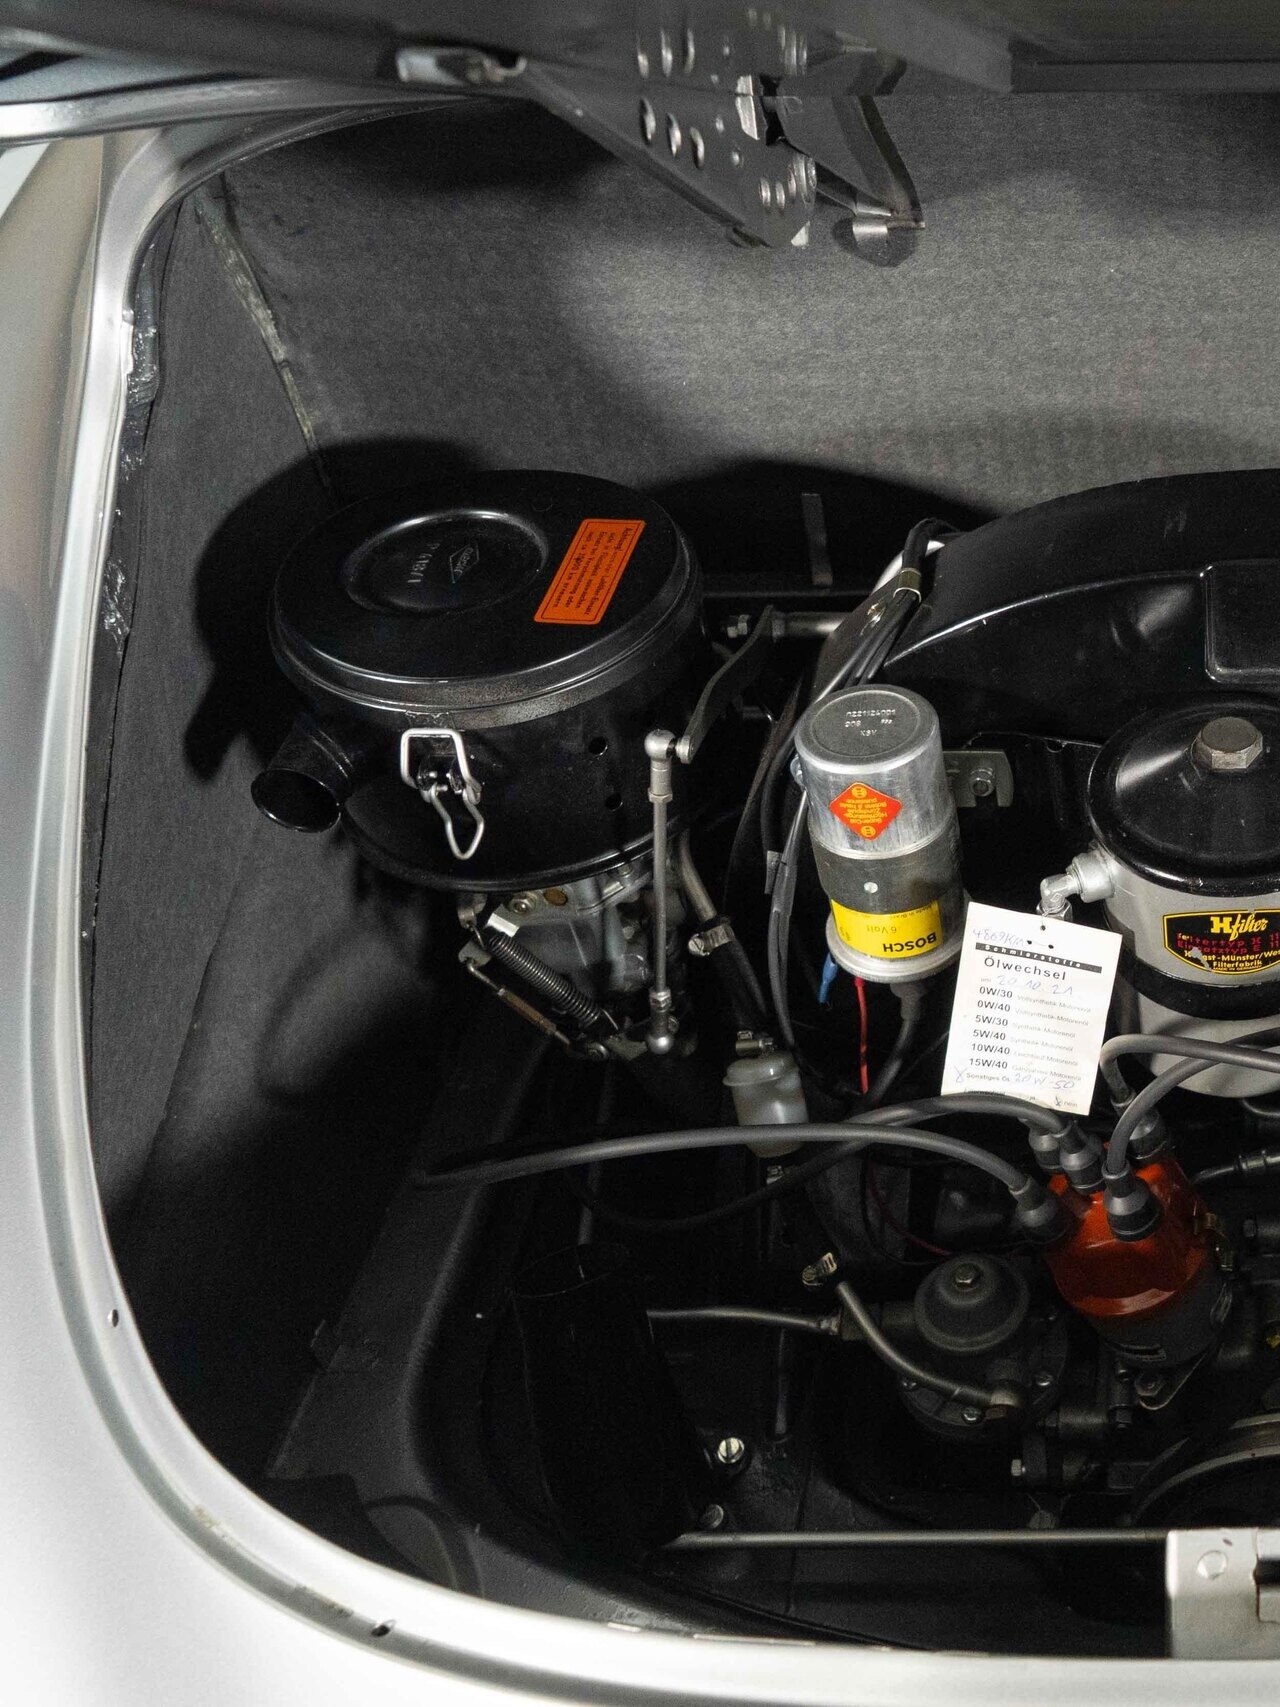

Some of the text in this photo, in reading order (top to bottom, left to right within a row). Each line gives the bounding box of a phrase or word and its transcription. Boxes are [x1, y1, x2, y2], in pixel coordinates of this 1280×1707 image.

[883, 932, 937, 953] BOSCH
[984, 944, 1082, 968] Schmierstoffe
[984, 955, 1067, 980] Ölwechsel
[1213, 960, 1263, 969] Filterfabrik
[979, 986, 1013, 999] 0W/30
[977, 1000, 1011, 1013] 0W/40
[975, 1015, 1008, 1027] 5W/30
[973, 1029, 1006, 1041] 5W/40
[971, 1043, 1010, 1055] 10W/40
[969, 1058, 1008, 1070] 15W/40
